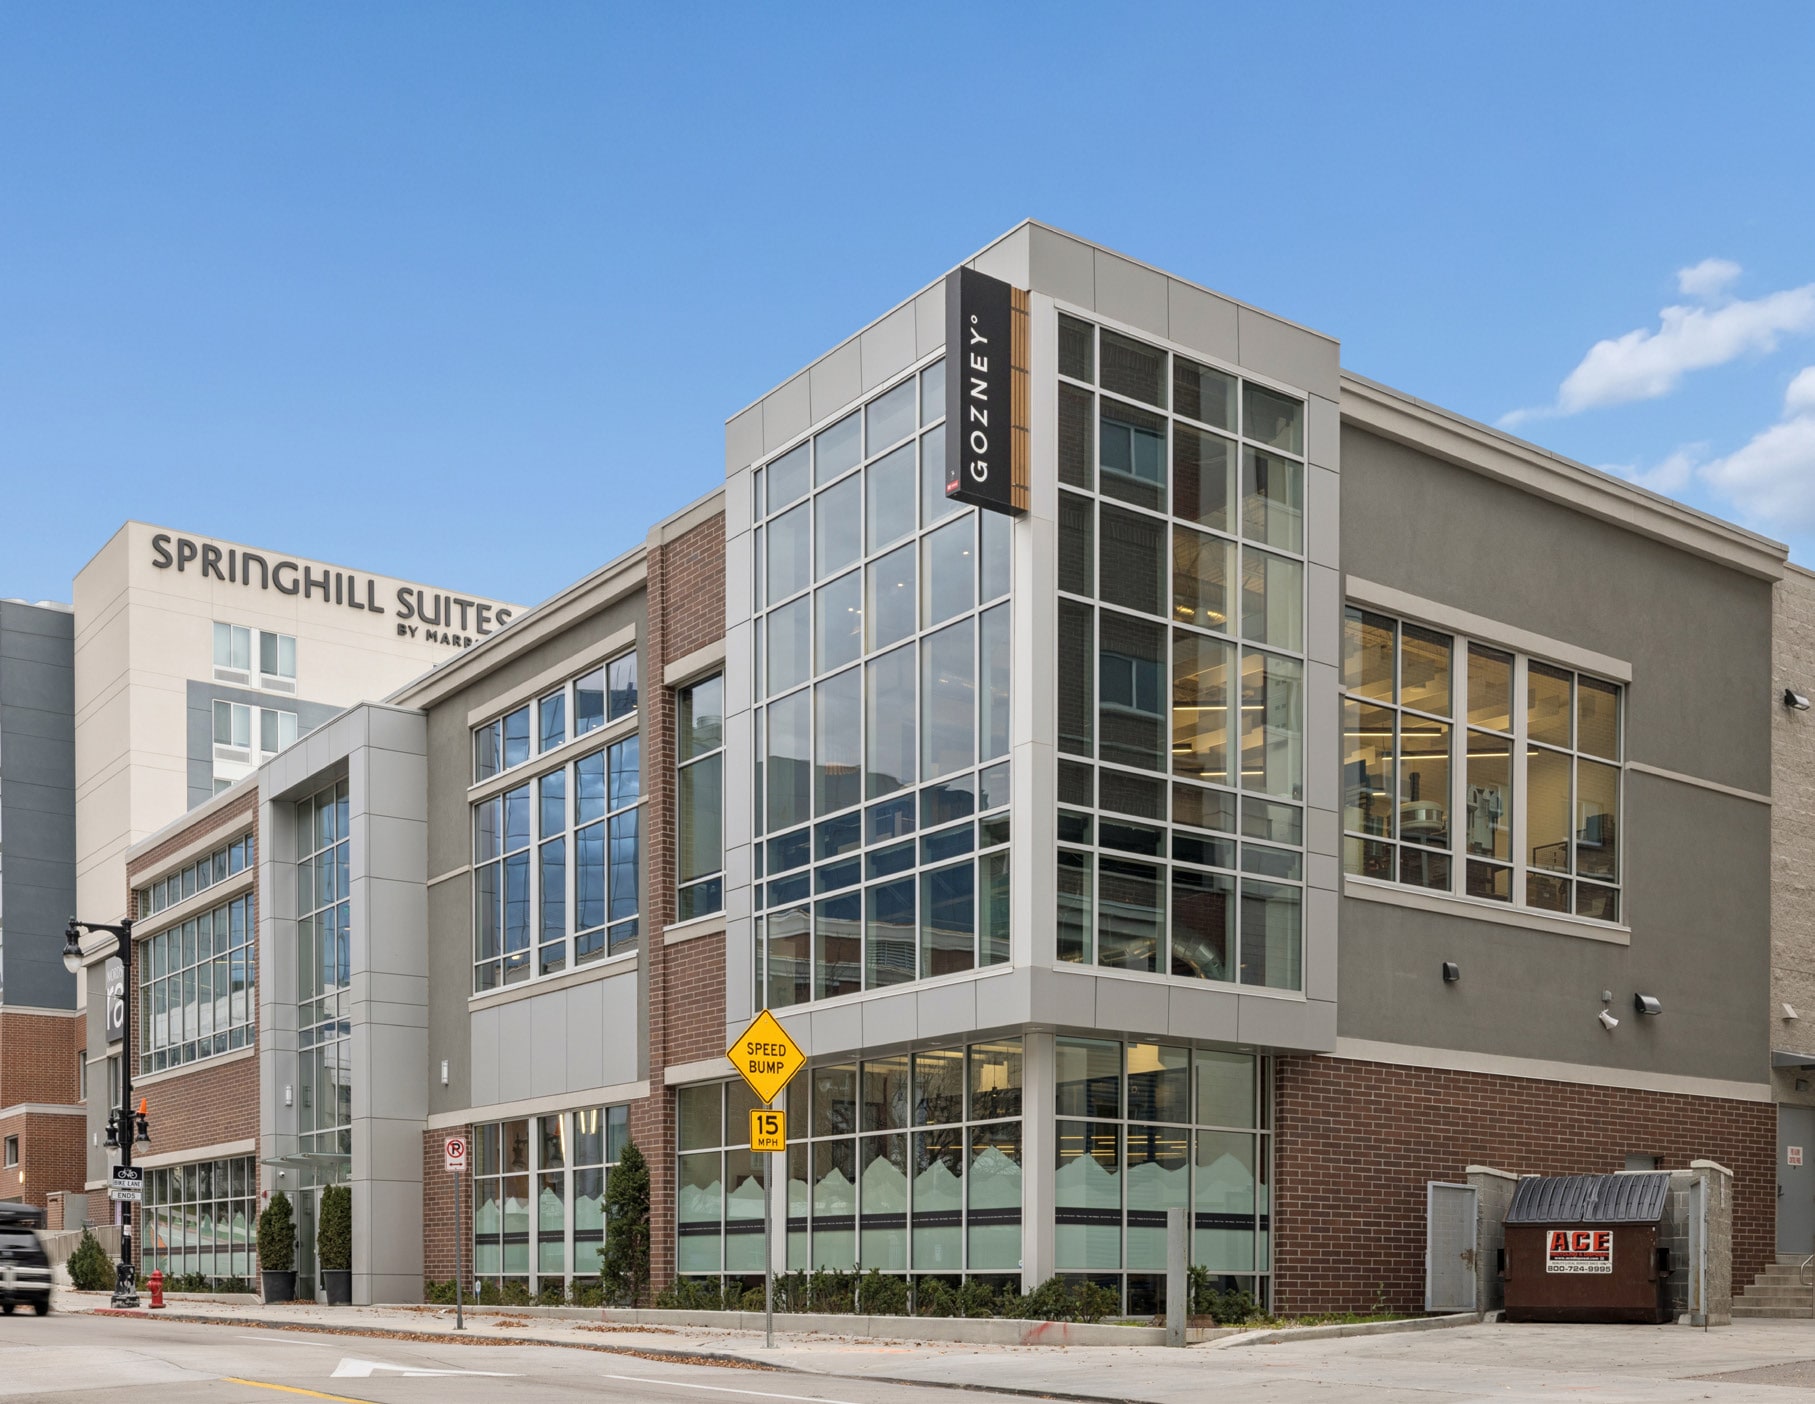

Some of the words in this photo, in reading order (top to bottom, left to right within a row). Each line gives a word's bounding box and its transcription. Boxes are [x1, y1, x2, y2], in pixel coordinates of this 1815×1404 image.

[152, 533, 385, 614] SPRINGHILL
[397, 623, 418, 638] BY
[426, 629, 479, 648] MARR
[747, 1042, 786, 1057] SPEED
[749, 1060, 784, 1074] BUMP
[757, 1115, 778, 1135] 15
[758, 1138, 778, 1146] MPH
[1550, 1231, 1610, 1251] ACE
